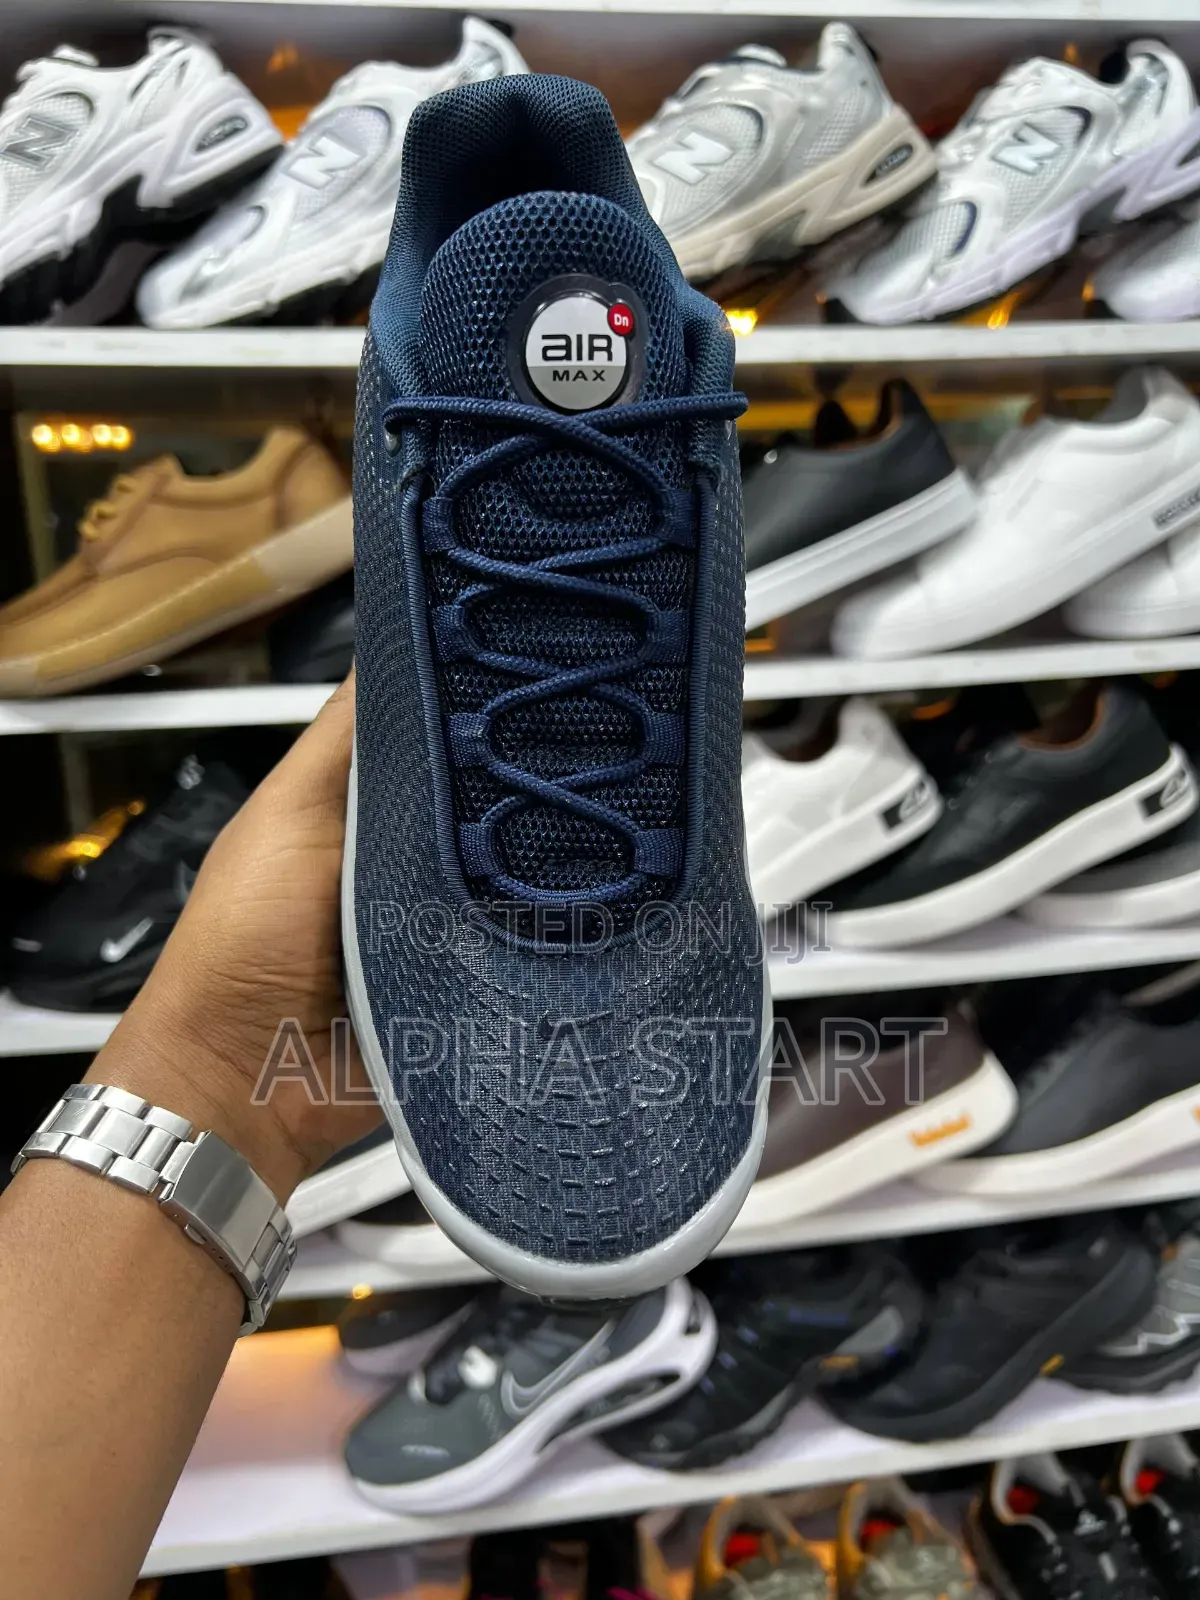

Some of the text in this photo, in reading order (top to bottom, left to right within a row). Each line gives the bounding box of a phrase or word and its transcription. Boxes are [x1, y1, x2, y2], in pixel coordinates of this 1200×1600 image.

[288, 136, 361, 188] N
[651, 131, 735, 185] N
[990, 122, 1062, 176] N
[613, 313, 629, 327] Dn
[552, 370, 606, 382] MAX
